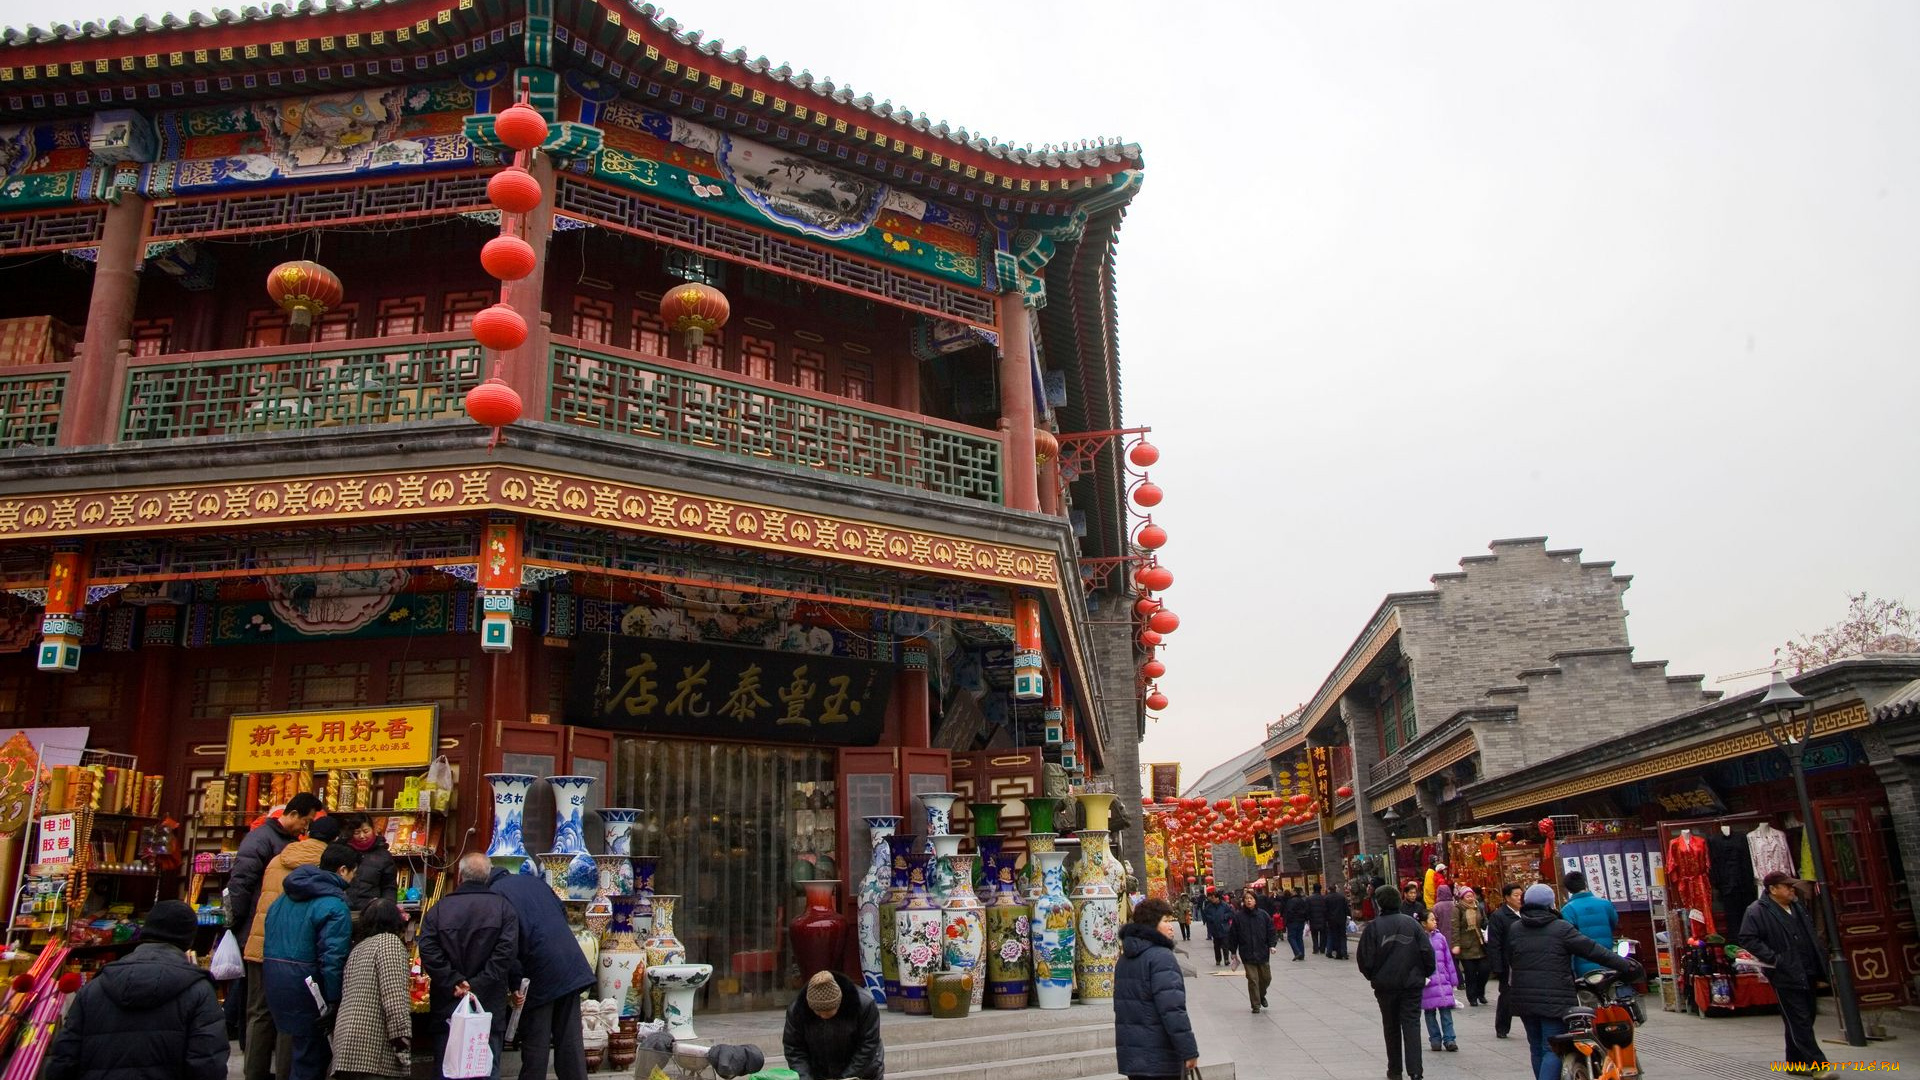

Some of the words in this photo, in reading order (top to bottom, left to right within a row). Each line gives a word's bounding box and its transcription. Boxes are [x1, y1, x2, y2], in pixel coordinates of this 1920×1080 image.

[249, 717, 414, 747] 新年用好香
[43, 818, 71, 832] 电池
[42, 836, 70, 851] 胶卷
